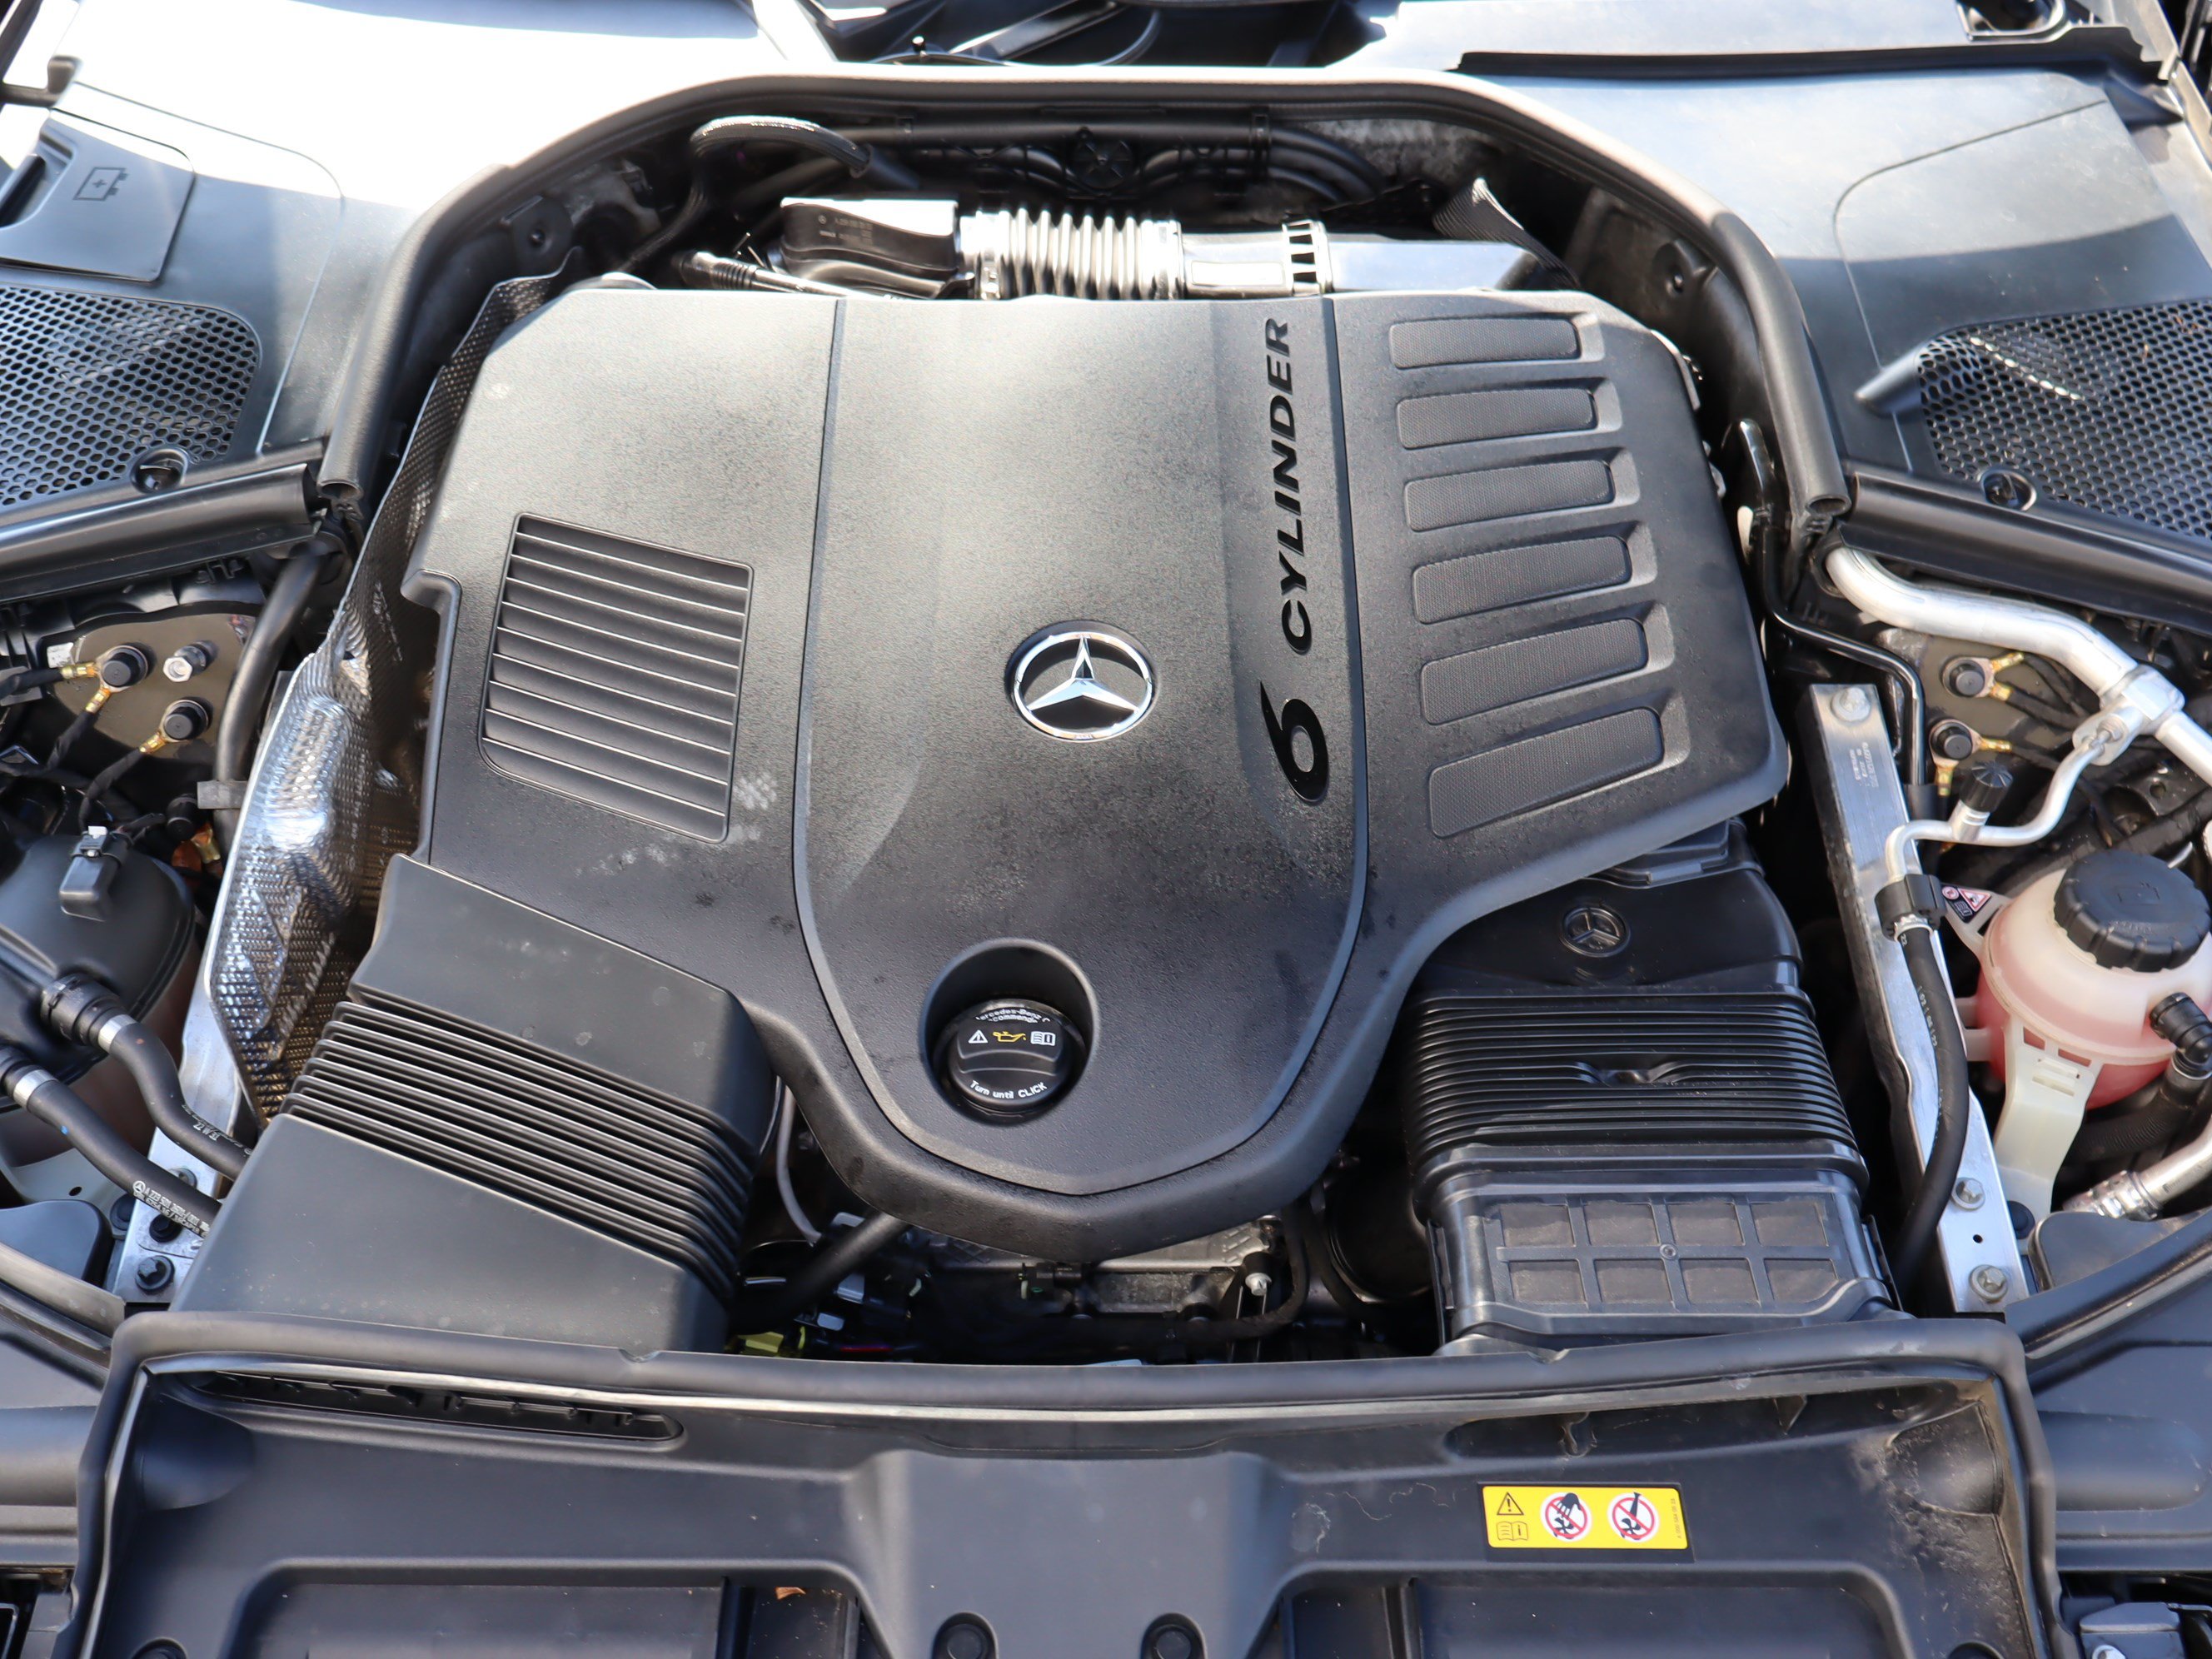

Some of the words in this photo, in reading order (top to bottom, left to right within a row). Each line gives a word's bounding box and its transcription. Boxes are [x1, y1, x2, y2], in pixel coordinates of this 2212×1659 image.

[1265, 318, 1313, 655] CYLINDER
[1260, 680, 1329, 804] 6
[970, 1080, 990, 1095] Turn
[993, 1090, 1014, 1099] until
[1018, 1082, 1048, 1099] CLICK
